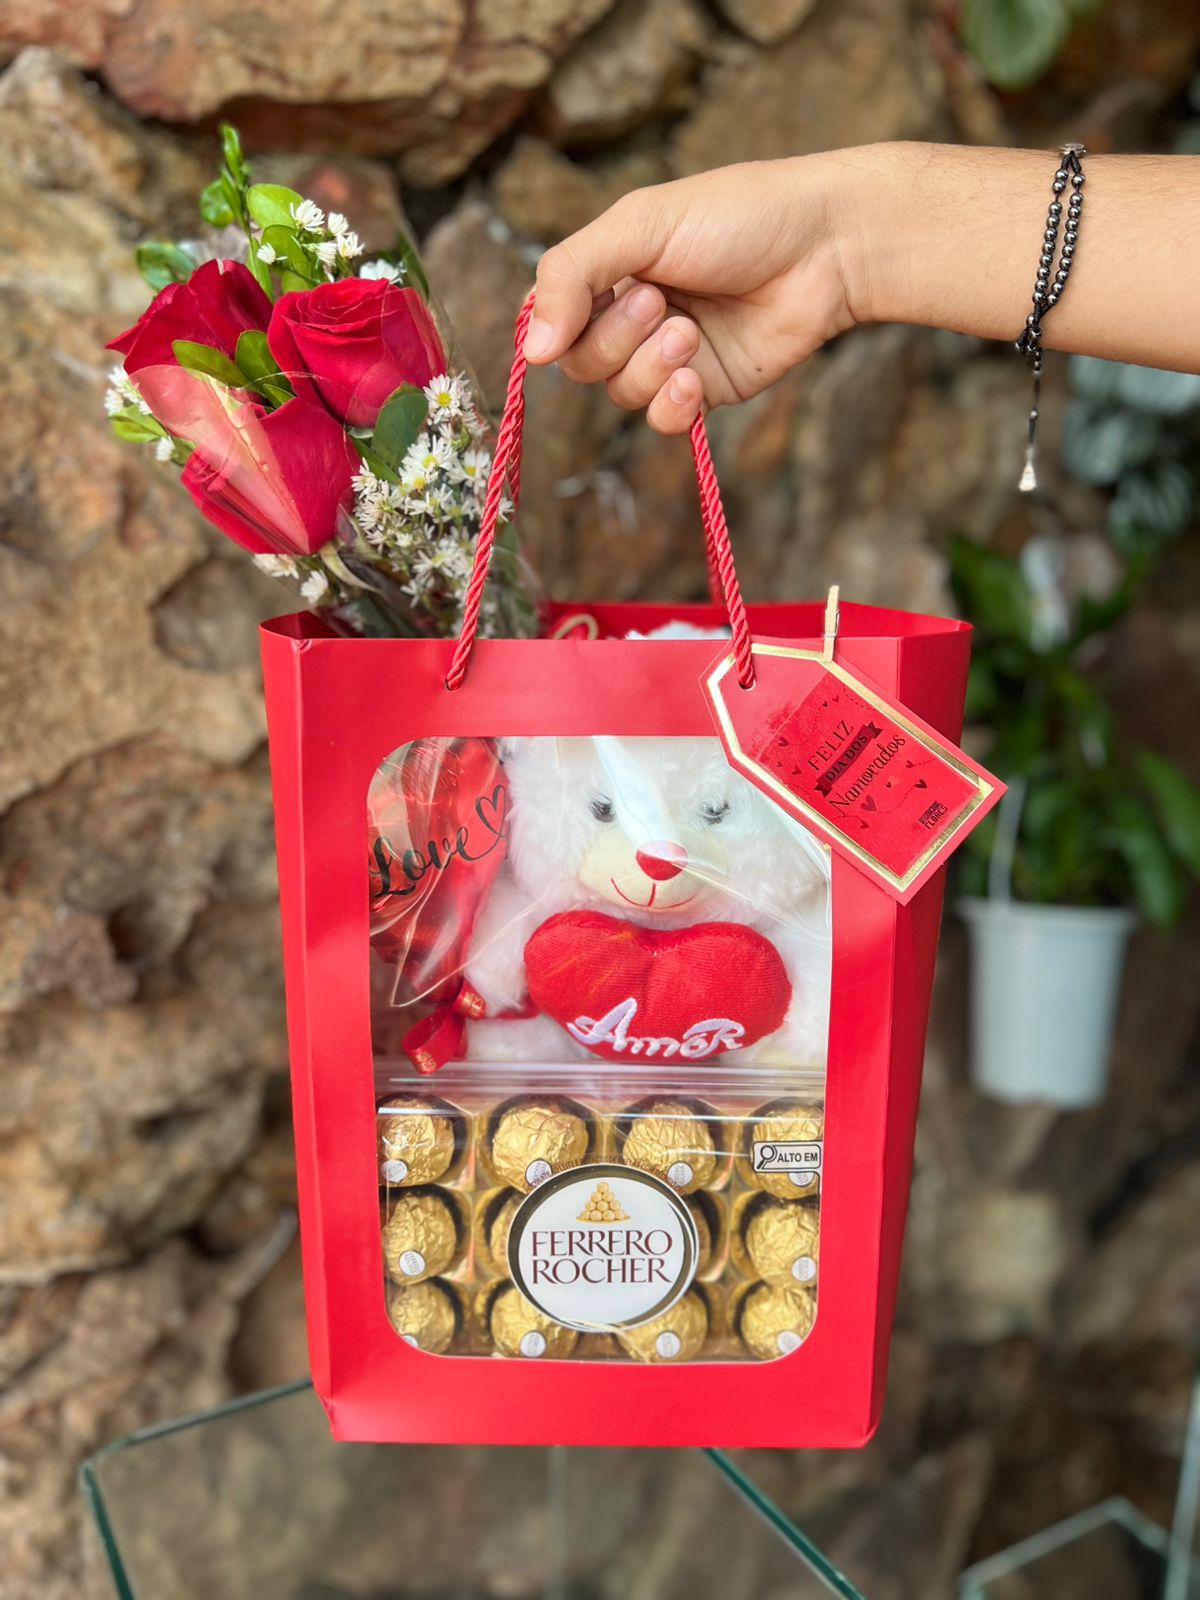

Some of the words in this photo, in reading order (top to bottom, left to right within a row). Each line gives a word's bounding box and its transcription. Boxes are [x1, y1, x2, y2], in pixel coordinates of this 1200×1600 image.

[808, 720, 854, 771] FELIZ
[824, 761, 848, 783] DIA
[844, 735, 868, 761] DOS
[829, 734, 906, 818] Namorados
[369, 818, 498, 897] Love
[777, 1152, 802, 1163] ALTO
[804, 1152, 818, 1162] EM
[532, 1229, 673, 1257] FERRERO
[532, 1258, 673, 1285] ROCHER
